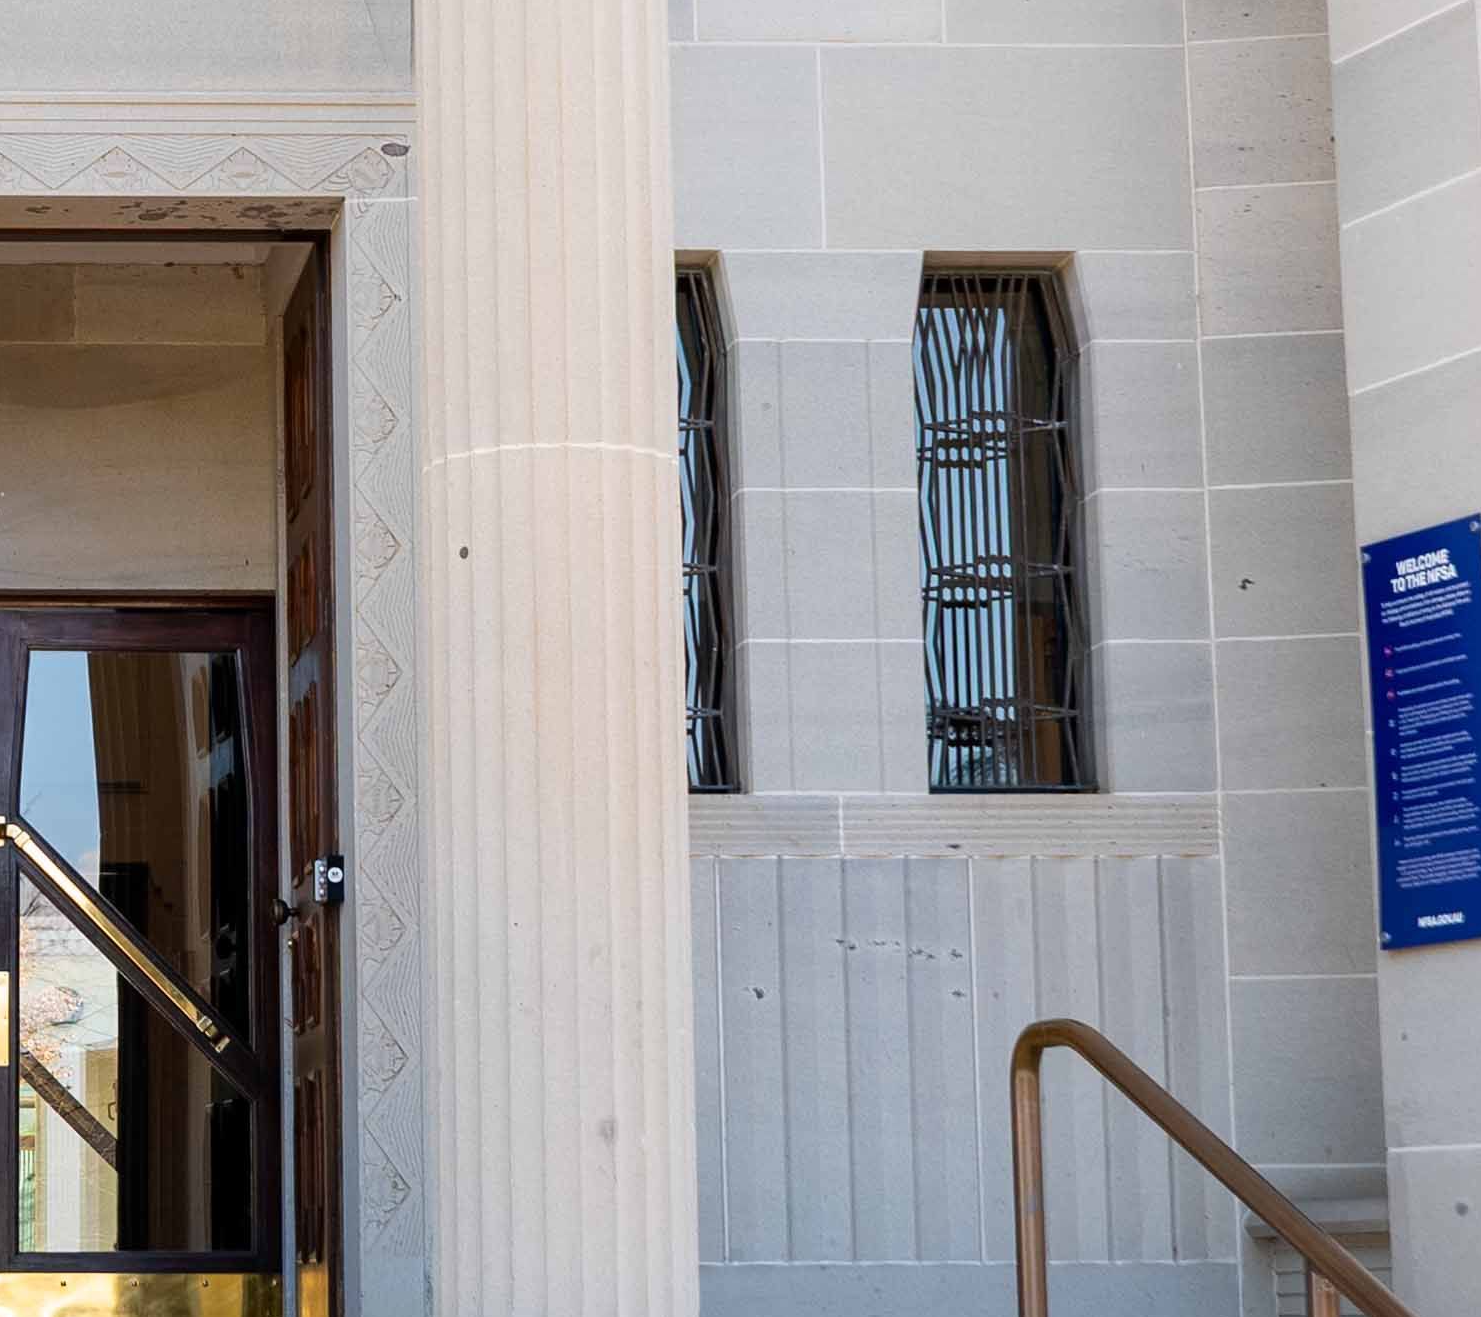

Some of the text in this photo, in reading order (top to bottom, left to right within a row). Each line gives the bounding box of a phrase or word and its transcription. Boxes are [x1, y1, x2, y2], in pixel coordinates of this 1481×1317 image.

[1396, 548, 1450, 575] WELCOME
[1390, 563, 1458, 593] TO THE NFSA
